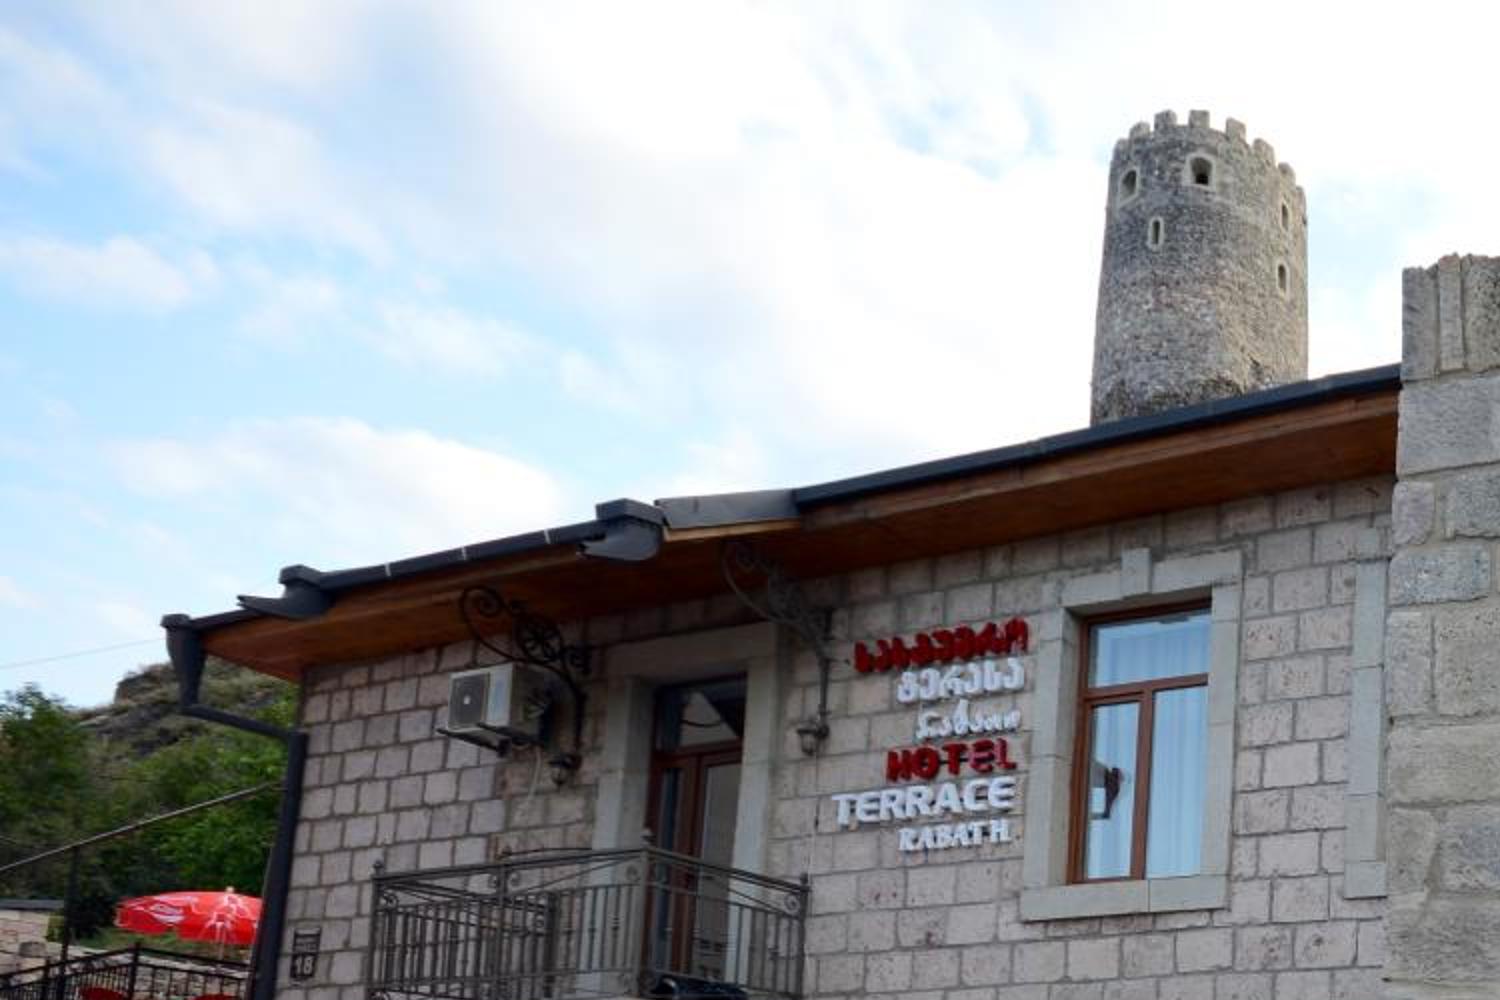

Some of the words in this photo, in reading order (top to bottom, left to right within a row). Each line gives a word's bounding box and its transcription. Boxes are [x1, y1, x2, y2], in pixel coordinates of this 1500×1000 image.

[898, 657, 1025, 702] ტერასა
[886, 738, 1016, 782] HOTEL
[832, 776, 1016, 825] TERRACE
[899, 818, 1010, 850] RABATH
